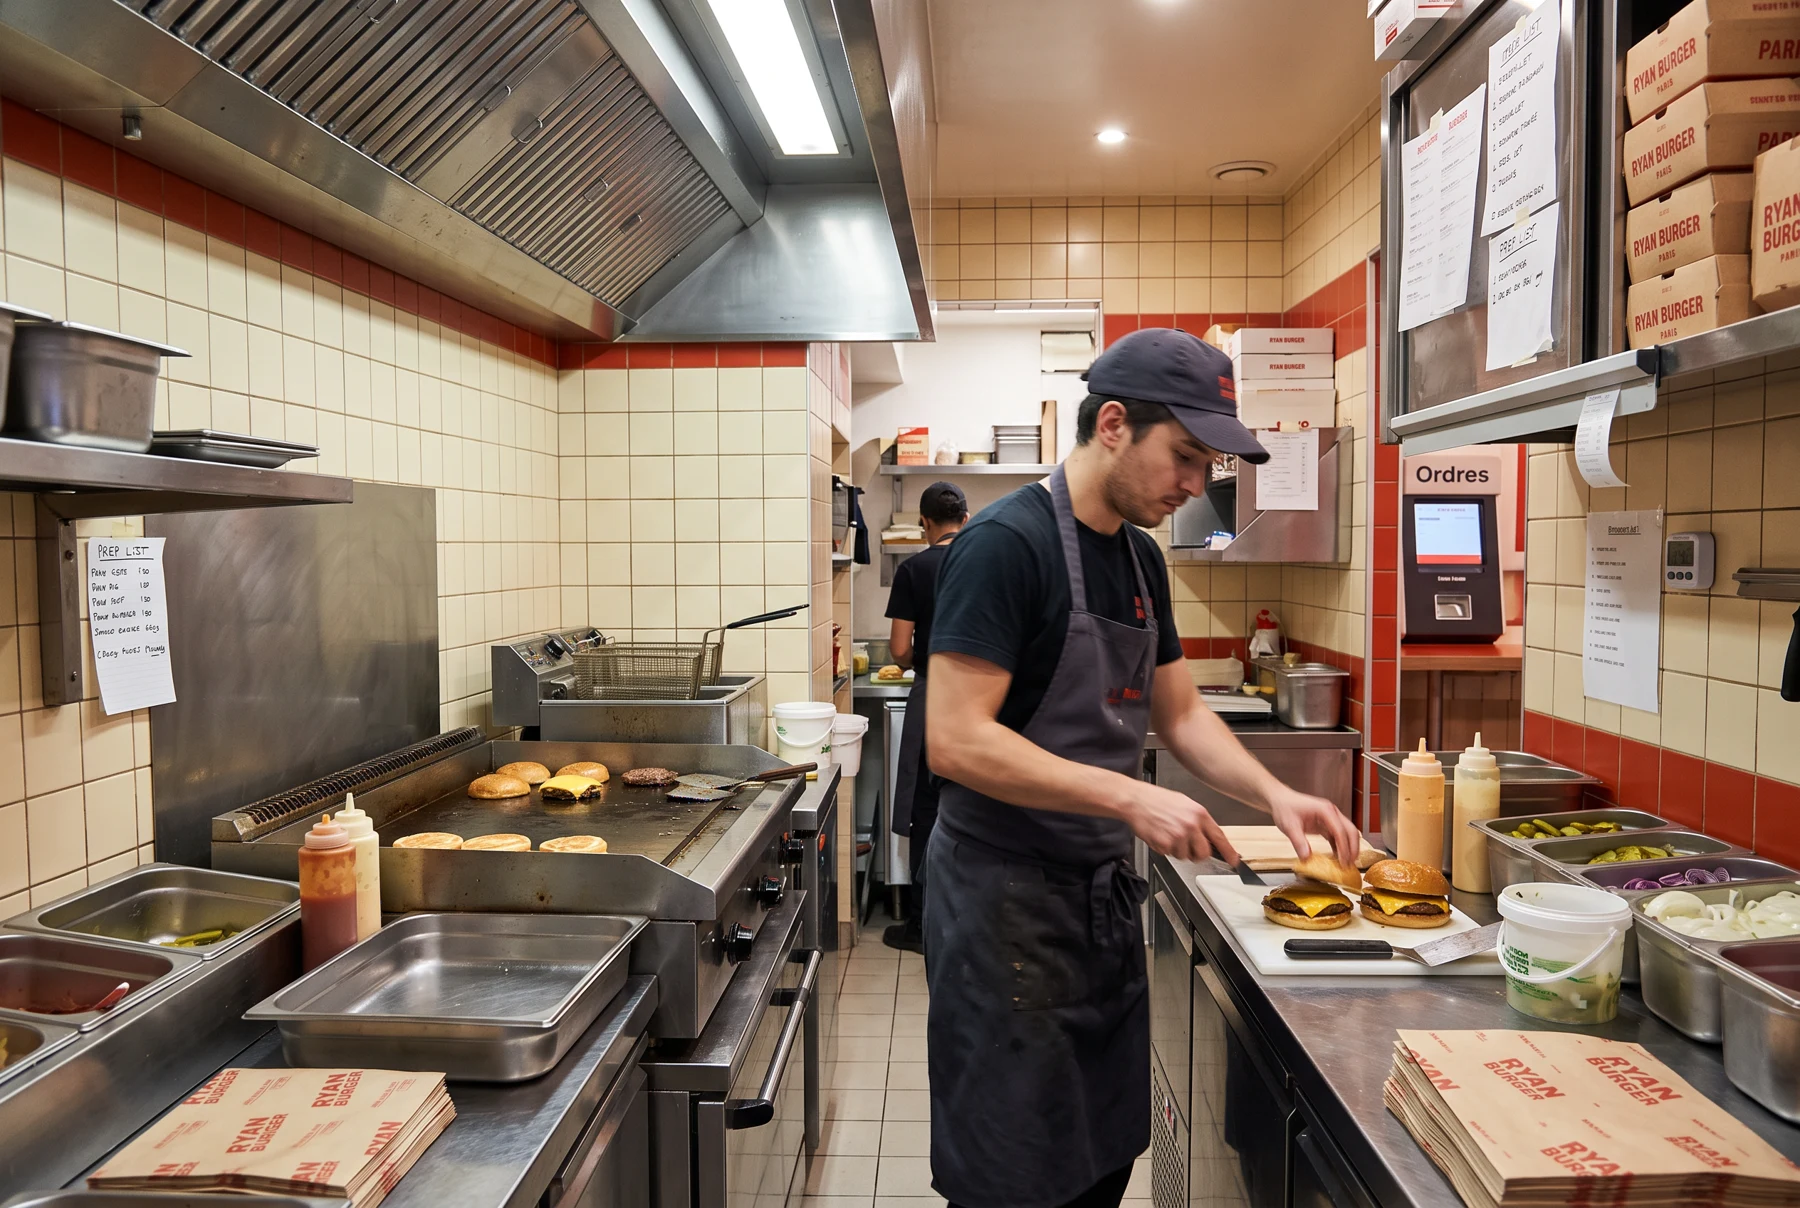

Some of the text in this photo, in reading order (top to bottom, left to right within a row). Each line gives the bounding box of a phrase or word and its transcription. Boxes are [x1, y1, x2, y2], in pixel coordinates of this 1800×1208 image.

[1633, 37, 1697, 95] RYAN BURGER
[1656, 78, 1674, 95] PARIS
[1631, 126, 1696, 178] RYAN BURGER
[1656, 164, 1673, 180] PARIS
[1633, 214, 1701, 258] RYAN BURGER
[1658, 249, 1676, 263] PARIS
[1634, 295, 1704, 333] RYAN BURGER
[1660, 327, 1678, 340] PARIS
[1416, 465, 1489, 483] Ordres
[98, 544, 119, 558] PREP
[311, 1073, 348, 1108] RYAN
[333, 1070, 364, 1107] BURGER
[1483, 1061, 1545, 1101] BURGER
[1499, 1057, 1566, 1099] RYAN
[1585, 1056, 1660, 1106] BURGER
[1602, 1056, 1684, 1101] RYAN
[225, 1116, 270, 1153] RYAN
[1558, 1141, 1634, 1177] RYA
